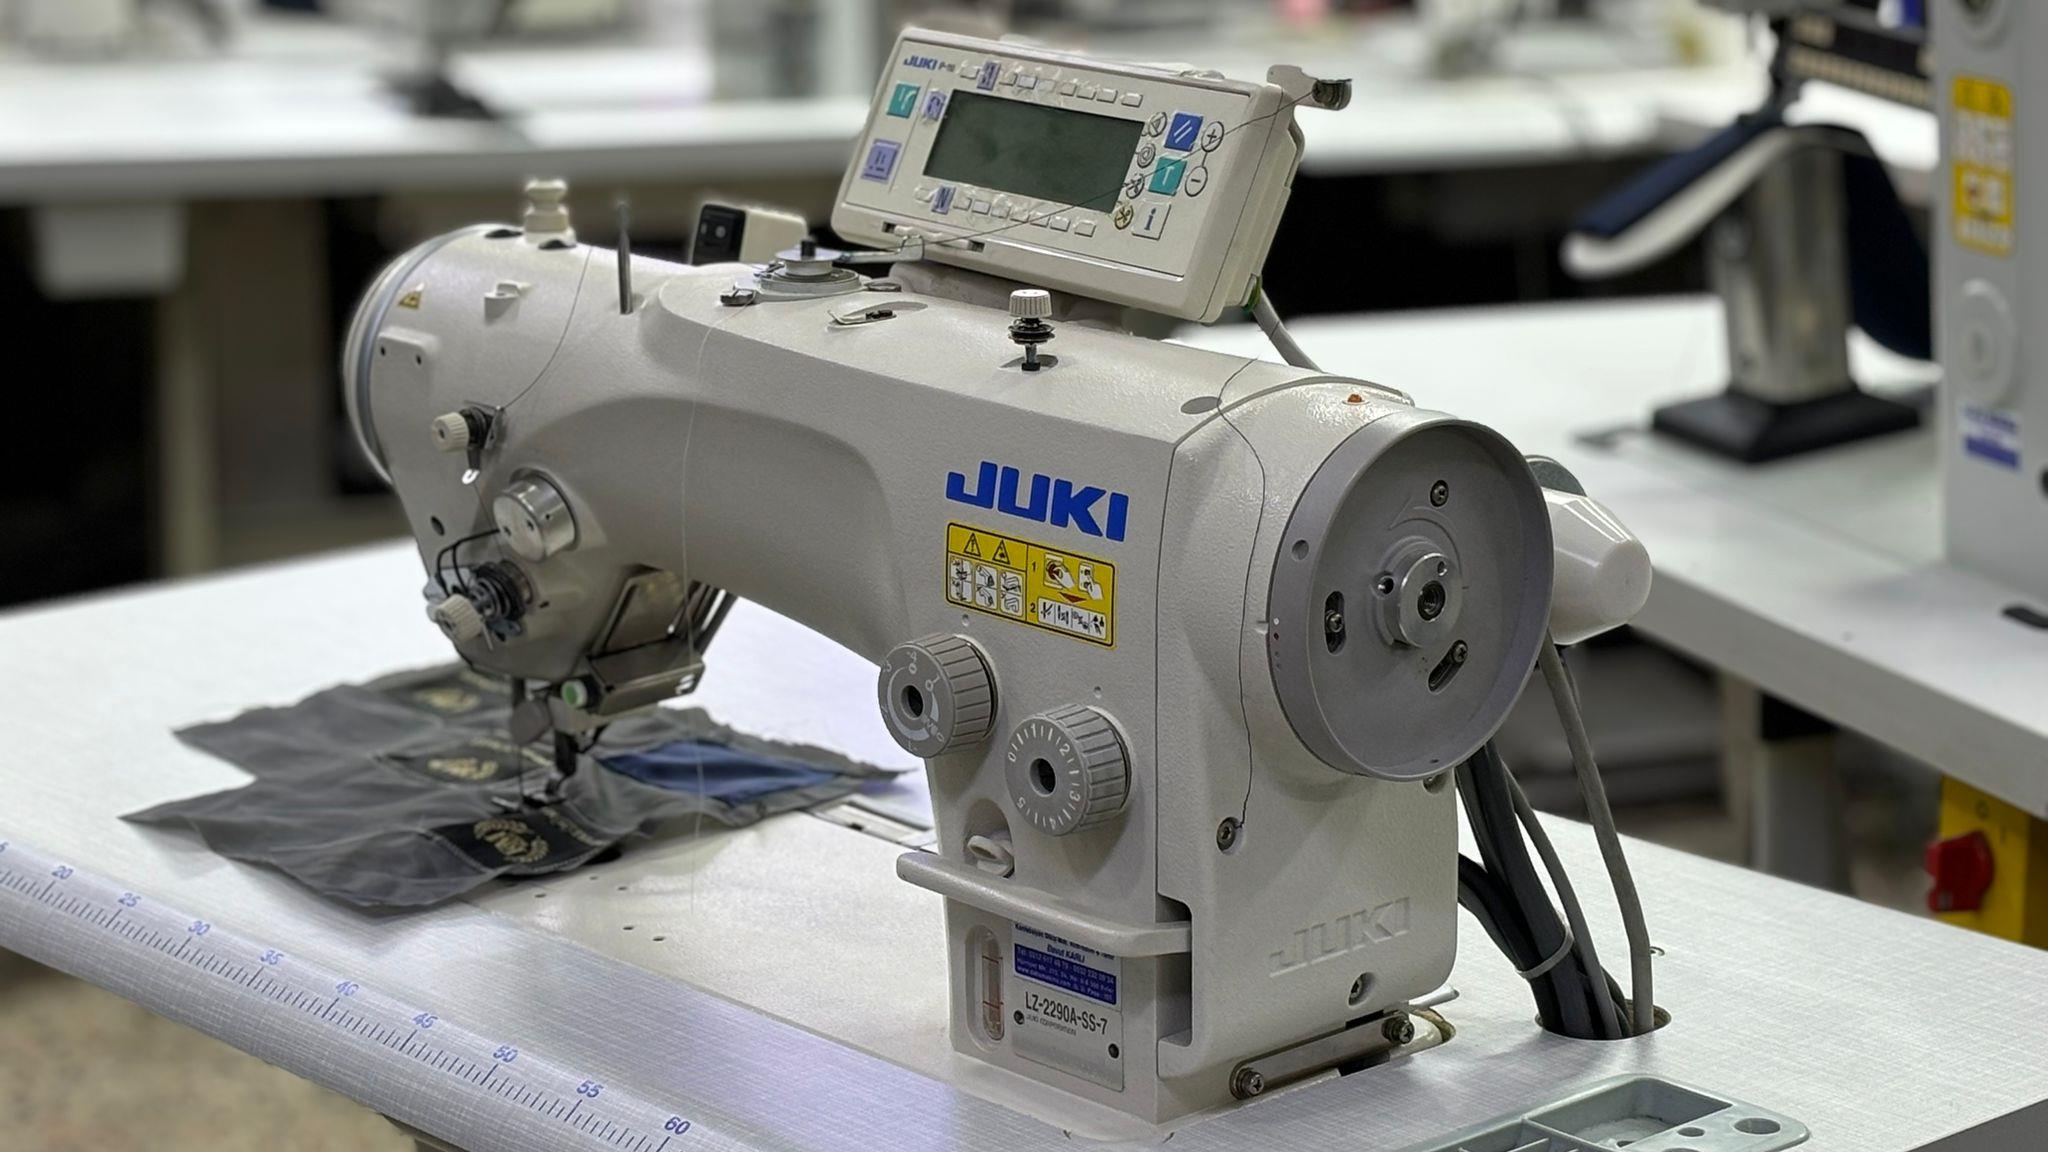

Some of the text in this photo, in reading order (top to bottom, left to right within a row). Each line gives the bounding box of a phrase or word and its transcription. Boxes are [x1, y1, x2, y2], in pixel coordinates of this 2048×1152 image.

[903, 55, 938, 70] JUKI
[946, 461, 1129, 542] JUKI
[1031, 561, 1037, 572] 1
[1029, 603, 1036, 613] 2
[1031, 723, 1036, 738] 1
[1008, 752, 1017, 762] 0
[1059, 744, 1070, 756] 2
[1016, 796, 1026, 809] 5
[1069, 790, 1081, 801] 3
[52, 866, 74, 880] 20
[118, 893, 142, 907] 25
[188, 921, 211, 936] 30
[1270, 897, 1411, 977] JUKI
[261, 950, 284, 965] 35
[412, 1013, 438, 1028] 45
[1025, 991, 1108, 1035] LZ-2290A-SS-7
[493, 1046, 518, 1063] 50
[576, 1080, 604, 1098] 55
[664, 1116, 691, 1135] 60
